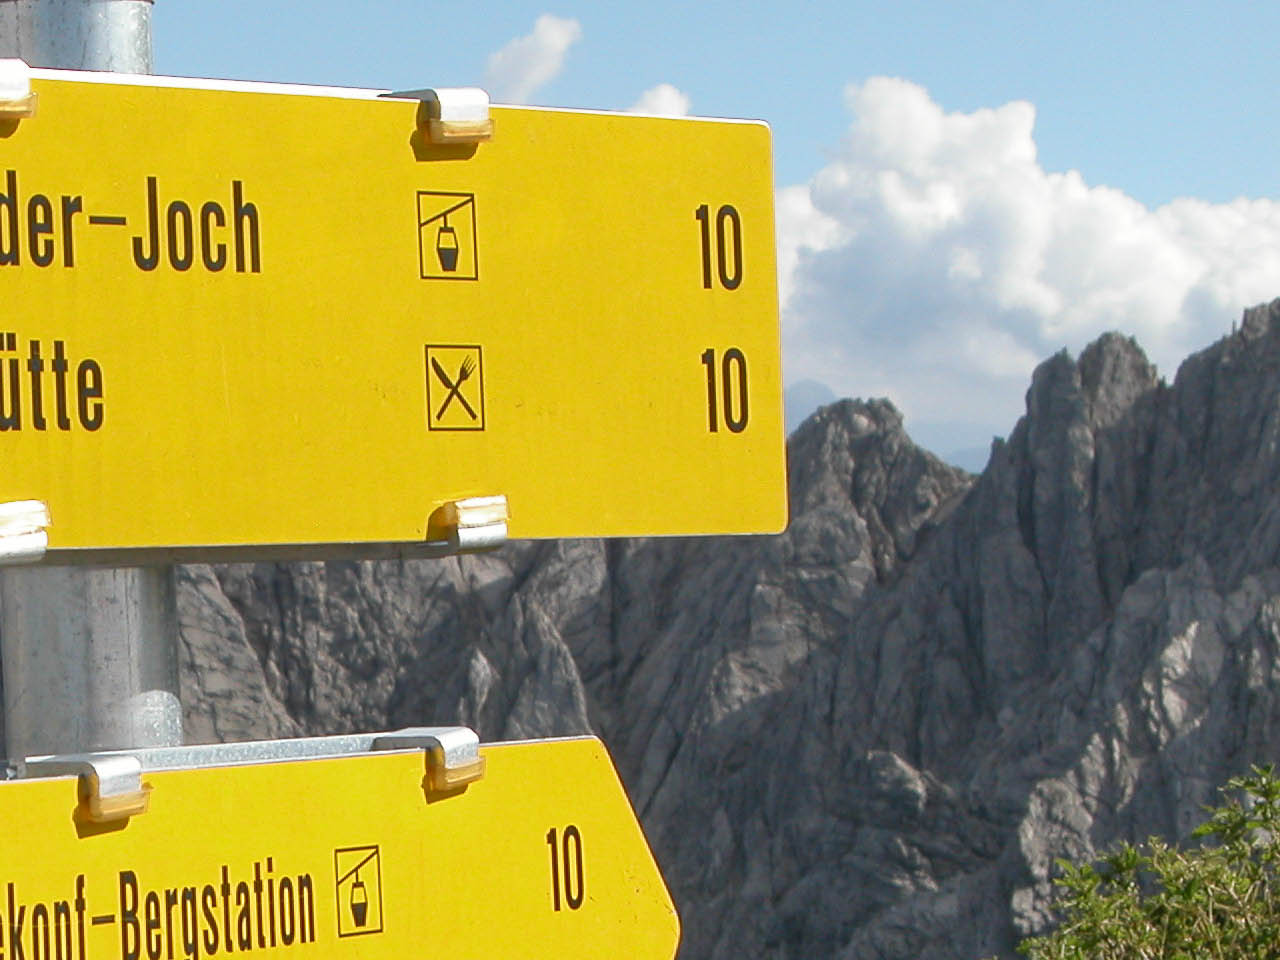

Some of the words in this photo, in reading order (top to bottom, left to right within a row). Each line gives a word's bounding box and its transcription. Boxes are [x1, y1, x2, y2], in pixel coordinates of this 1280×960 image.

[695, 204, 743, 291] 10
[701, 347, 749, 434] 10
[547, 825, 584, 912] 10
